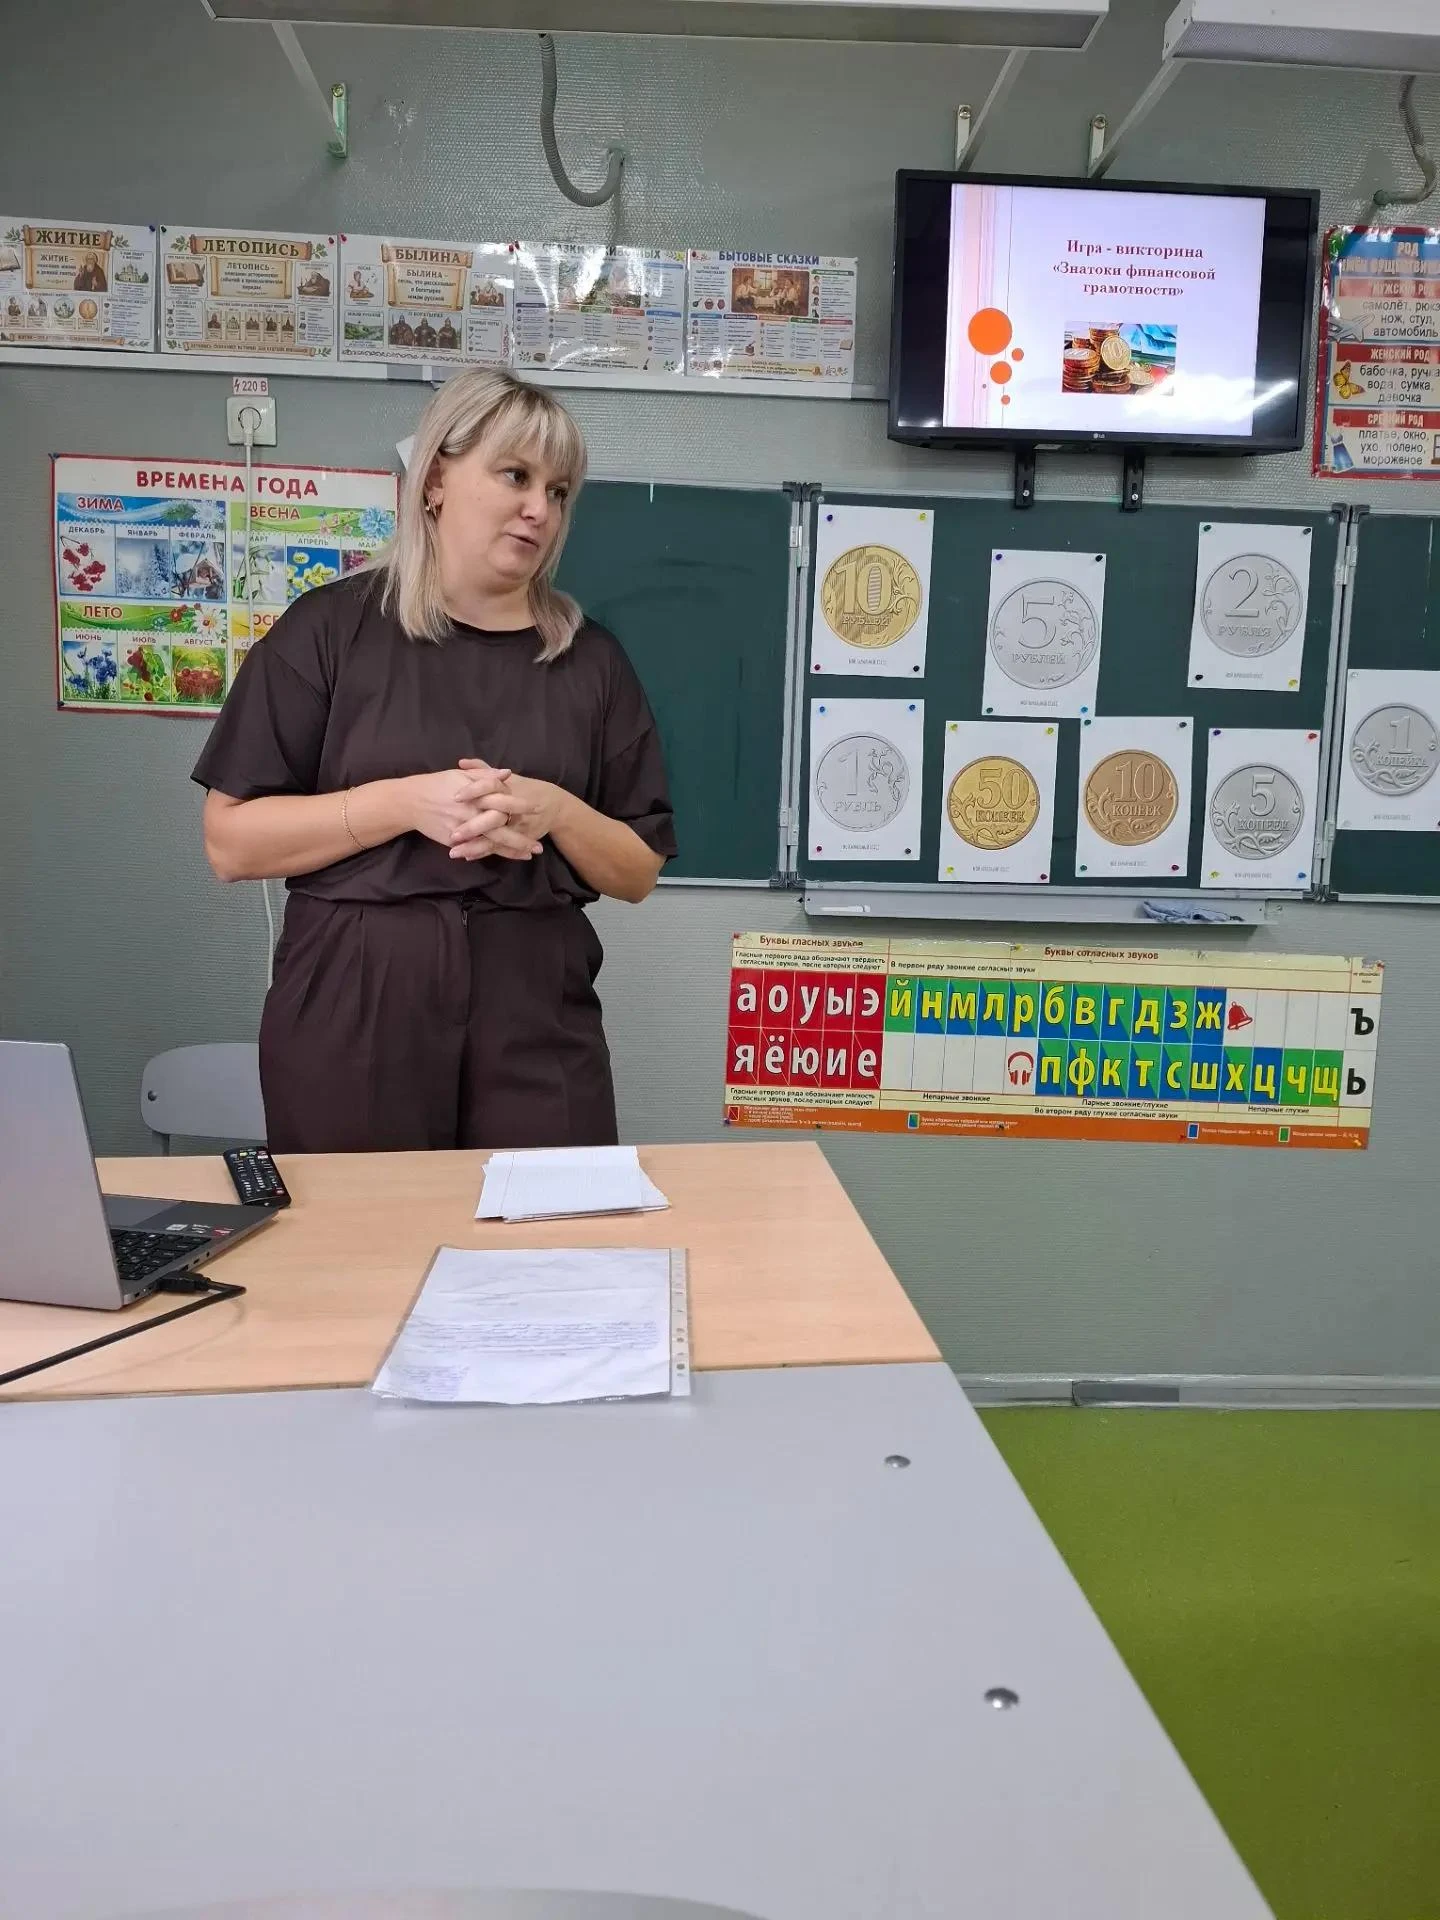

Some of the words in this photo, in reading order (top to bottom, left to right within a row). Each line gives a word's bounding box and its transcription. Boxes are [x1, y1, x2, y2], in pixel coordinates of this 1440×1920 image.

[36, 231, 101, 247] ЖИТИЕ
[202, 239, 300, 257] ЛЕТОПИСЬ
[1066, 238, 1103, 257] Игра
[1116, 245, 1204, 260] викторина
[1397, 242, 1419, 257] РОД
[395, 248, 462, 264] БЫЛИНА
[719, 251, 772, 263] БЫТОВЫЕ
[777, 254, 820, 265] СКАЗКИ
[226, 262, 270, 271] ЛЕТОПИСЬ
[406, 269, 442, 278] БЫЛИНА
[1053, 262, 1122, 277] «Знатоки
[1125, 264, 1216, 282] финансовой
[1083, 282, 1184, 297] грамотности»
[1409, 315, 1435, 327] стул,
[1370, 346, 1411, 361] ЖЕНСКИЙ
[1414, 350, 1430, 364] РОД
[1360, 365, 1408, 378] бабочка,
[242, 380, 258, 392] 220
[260, 381, 267, 392] В
[1408, 414, 1424, 428] РОД
[1403, 430, 1430, 441] окно,
[1363, 455, 1423, 467] мороженое
[136, 471, 245, 493] ВРЕМЕНА
[257, 476, 319, 499] ГОДА
[77, 496, 125, 512] ЗИМА
[250, 506, 301, 520] ВЕСНА
[68, 526, 105, 534] ДЕКАБРЬ
[178, 532, 216, 540] ФЕВРАЛЬ
[298, 537, 329, 546] АПРЕЛЬ
[358, 541, 377, 549] МАЙ
[835, 559, 894, 615] 10
[1224, 568, 1260, 618] 2
[83, 605, 122, 619] ЛЕТО
[841, 614, 891, 626] РУБЛЕЙ
[1018, 595, 1056, 650] 5
[1217, 625, 1271, 638] РУБЛЯ
[132, 636, 157, 644] ИЮЛЬ
[1011, 652, 1067, 665] РУБЛЕЙ
[1389, 715, 1414, 754] 1
[1375, 752, 1429, 768] КОПЕЙКА
[838, 749, 859, 797] 1
[1113, 759, 1165, 802] 10
[976, 768, 1030, 810] 50
[1248, 773, 1277, 817] 5
[833, 800, 882, 813] РУБЛЬ
[1111, 804, 1162, 817] КОПЕЕК
[975, 809, 1026, 823] КОПЕЕК
[1237, 819, 1291, 832] КОПЕЕК
[760, 935, 790, 945] Буквы
[792, 938, 830, 947] гласных
[1044, 946, 1074, 957] Буквы
[1076, 948, 1125, 958] согласных
[1127, 951, 1159, 960] звуков
[922, 1093, 960, 1101] Непарные
[1081, 1098, 1110, 1107] Парные
[1247, 1105, 1283, 1113] Непарные
